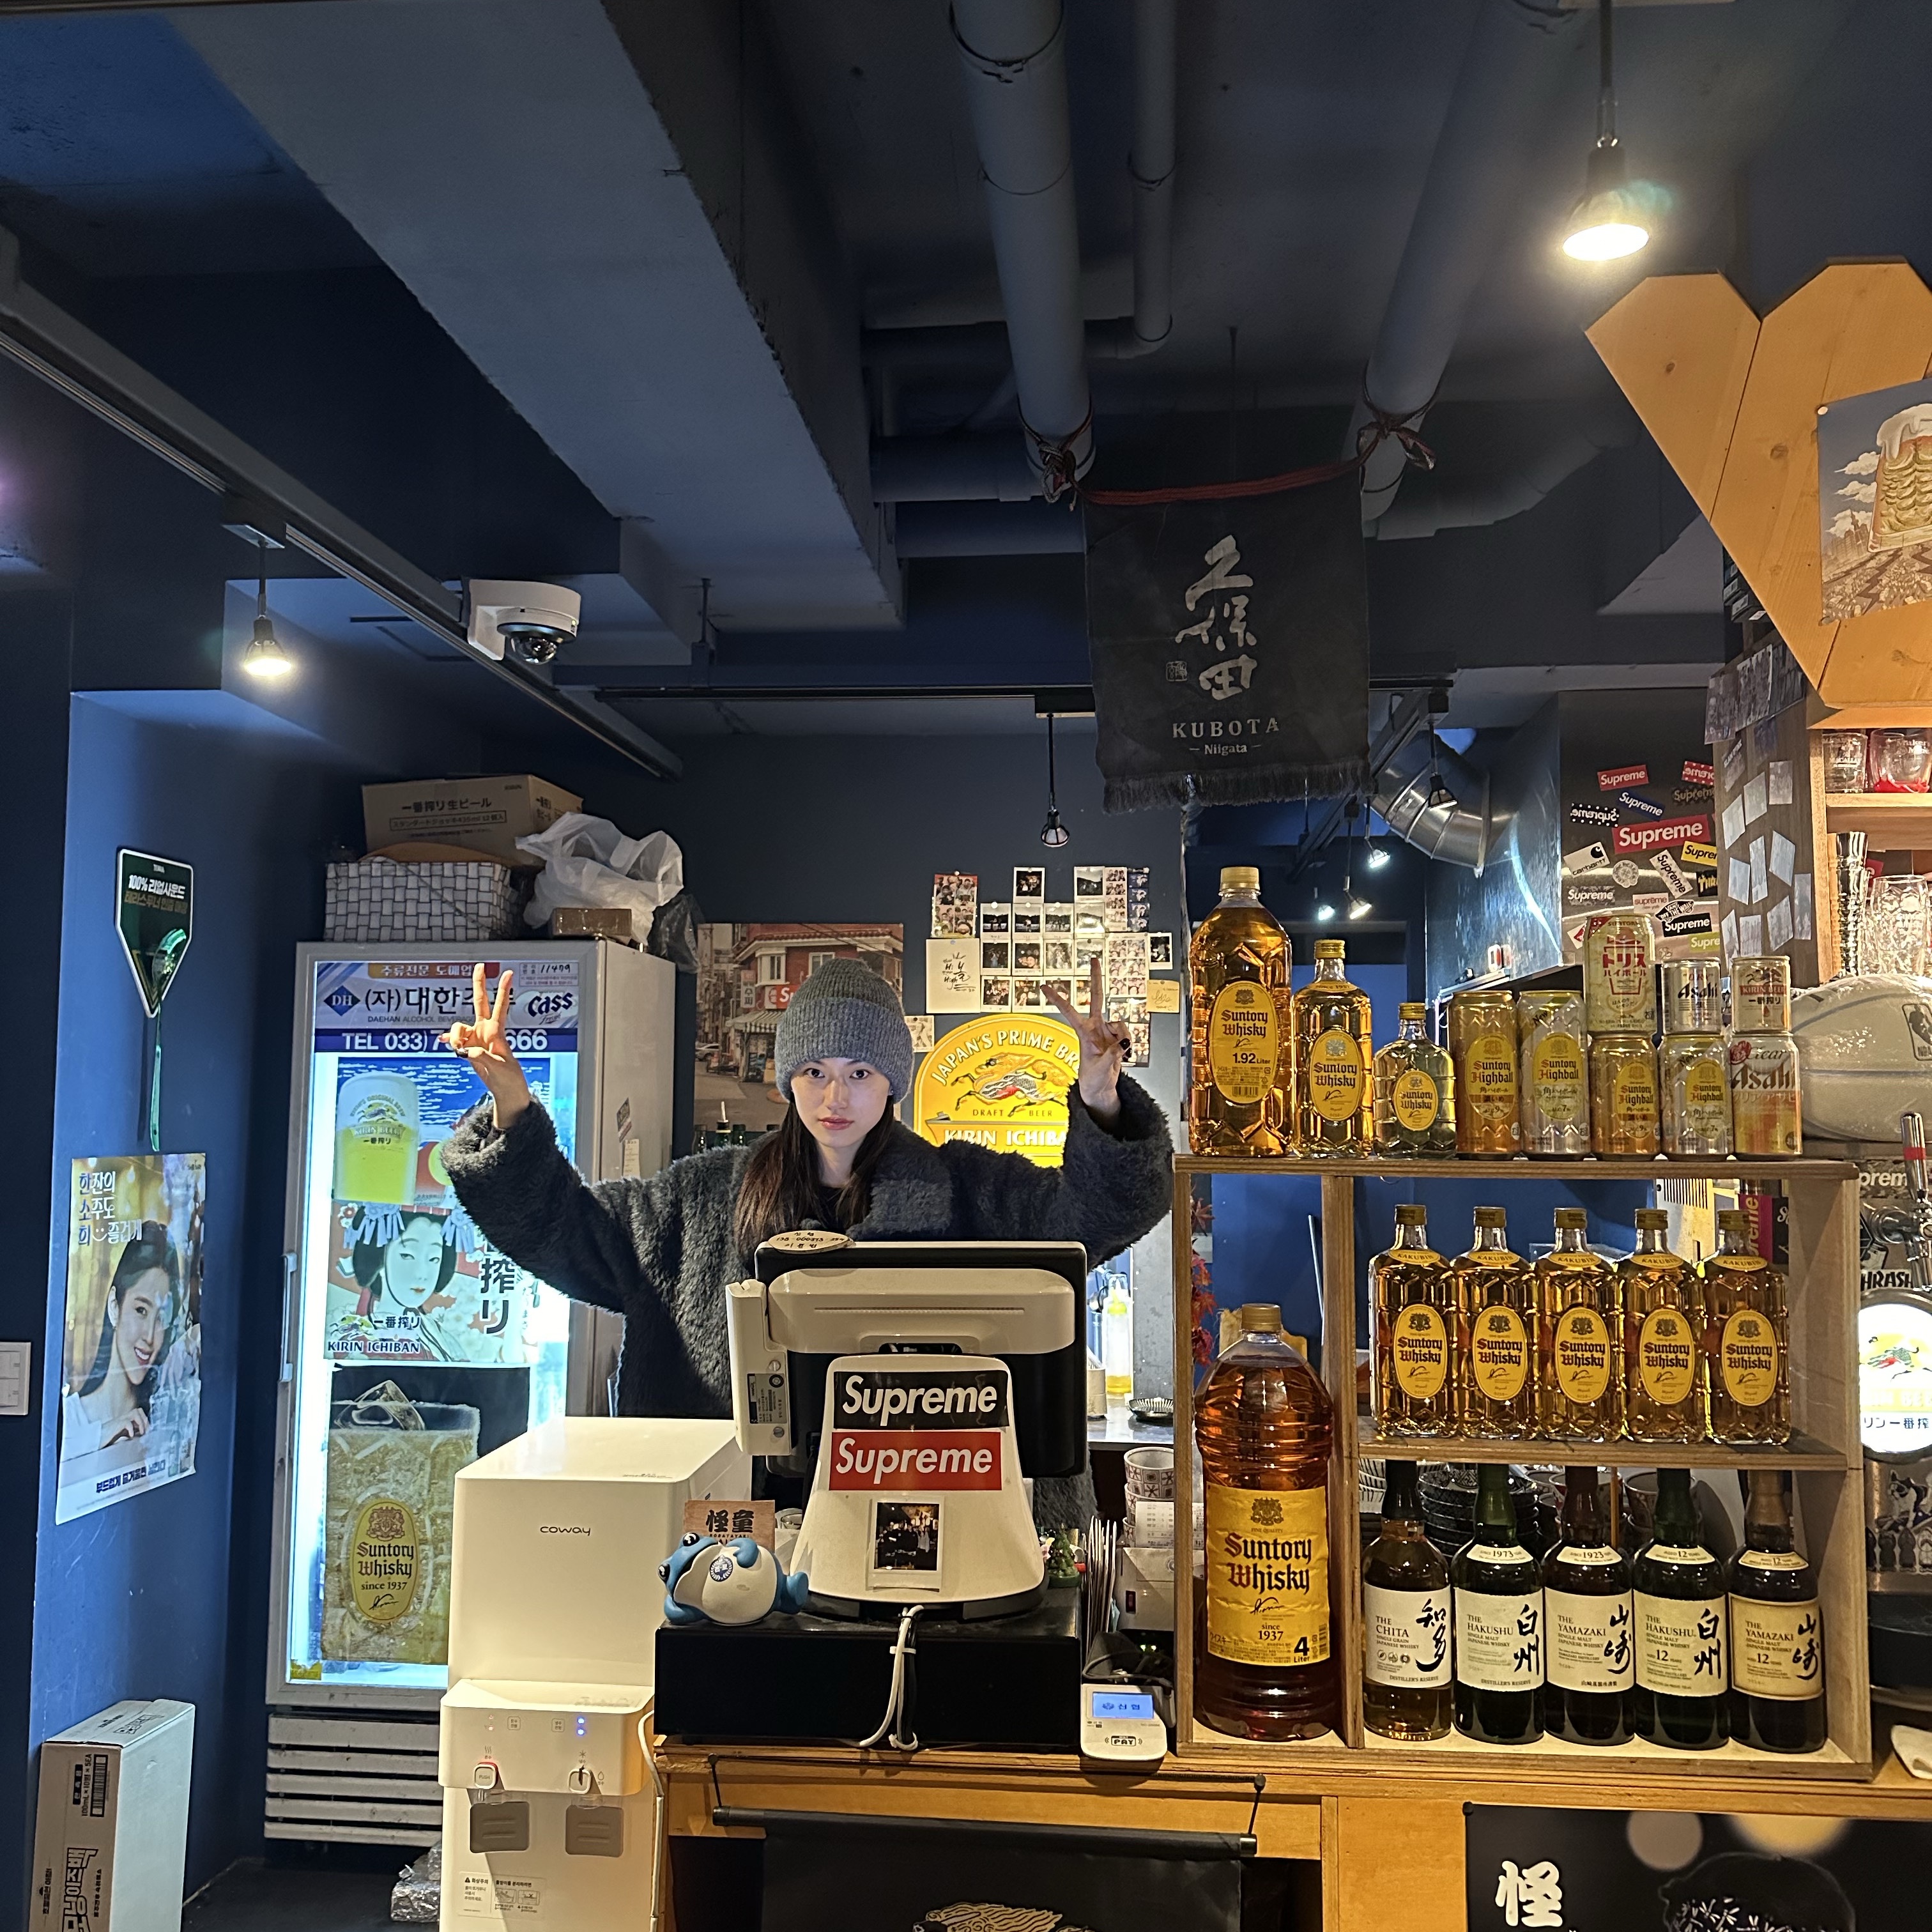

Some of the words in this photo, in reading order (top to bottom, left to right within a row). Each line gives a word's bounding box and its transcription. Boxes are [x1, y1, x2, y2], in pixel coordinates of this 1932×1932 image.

[1175, 534, 1257, 701] 久保田
[1173, 717, 1280, 739] KUBOTA
[1600, 770, 1646, 786] Supreme
[1619, 792, 1663, 816] Supreme
[1619, 822, 1703, 850] Supreme
[1572, 858, 1606, 876] carhartt
[1657, 854, 1686, 893] Supreme
[128, 875, 148, 891] 100%
[148, 878, 186, 900] 리얼사운드
[1567, 889, 1614, 903] Supreme
[1664, 918, 1710, 933] Supreme
[1690, 937, 1720, 950] Supre
[1602, 953, 1646, 969] トリス
[379, 965, 431, 977] 주류전문
[1678, 982, 1718, 999] Asahi
[330, 995, 354, 1007] DH
[528, 992, 573, 1018] Cass
[1748, 997, 1781, 1005] 一番搾り
[1220, 1009, 1268, 1025] Suntory
[1222, 1023, 1267, 1039] Whisky
[342, 1032, 379, 1050] TEL
[931, 1032, 993, 1086] JAPAN'S
[997, 1029, 1054, 1052] PRIME
[1232, 1052, 1256, 1064] 1.92
[1540, 1059, 1577, 1070] Suntory
[1313, 1062, 1358, 1076] Suntory
[1473, 1060, 1511, 1071] Suntory
[1314, 1074, 1356, 1089] Whisky
[1471, 1071, 1514, 1086] Highball
[1538, 1069, 1579, 1082] Highball
[1399, 1090, 1433, 1102] Suntory
[1620, 1085, 1652, 1094] Suntory
[1692, 1084, 1722, 1093] Suntory
[1618, 1093, 1654, 1107] Highball
[1690, 1092, 1723, 1103] Highball
[1400, 1100, 1432, 1112] Whisky
[944, 1130, 997, 1147] KIRIN
[1006, 1130, 1067, 1146] ICHIBA
[79, 1170, 116, 1195] 한잔의
[1859, 1172, 1907, 1187] prem
[79, 1196, 116, 1221] 소주도
[79, 1224, 92, 1246] 희
[107, 1218, 142, 1244] 즐겁게
[1397, 1252, 1434, 1261] KAKUBIN
[1476, 1254, 1514, 1262] KAKUBIN
[1722, 1259, 1761, 1267] KAKUBIN
[374, 1315, 422, 1330] 一番搾り
[327, 1341, 363, 1353] KIRIN
[367, 1342, 420, 1353] ICHIBAN
[1397, 1336, 1443, 1351] Suntory
[1476, 1337, 1523, 1353] Suntory
[1558, 1340, 1606, 1354] Suntory
[1643, 1341, 1690, 1357] Suntory
[1725, 1343, 1773, 1358] Suntory
[1398, 1350, 1441, 1365] Whisky
[1477, 1351, 1522, 1367] Whisky
[1560, 1353, 1604, 1368] Whisky
[1644, 1354, 1689, 1370] Whisky
[1726, 1356, 1772, 1372] Whisky
[842, 1374, 998, 1427] Supreme
[835, 1438, 993, 1485] Supreme
[705, 1509, 755, 1533] 怪童
[539, 1524, 592, 1537] coway
[356, 1542, 415, 1561] Suntory
[1223, 1531, 1312, 1565] Suntory
[1583, 1551, 1605, 1559] 1923
[358, 1559, 413, 1579] Whisky
[360, 1581, 385, 1591] since
[387, 1581, 408, 1591] 1937
[1226, 1562, 1310, 1596] Whisky
[1376, 1615, 1392, 1625] THE
[1467, 1614, 1482, 1624] THE
[1557, 1614, 1574, 1625] THE
[1645, 1614, 1661, 1625] THE
[1745, 1620, 1763, 1630] THE
[1257, 1630, 1284, 1641] 1937
[1376, 1624, 1409, 1637] CHITA
[1467, 1622, 1514, 1636] HAKUSHU
[1558, 1623, 1606, 1637] YAMAZAKI
[1745, 1629, 1794, 1642] YAMAZAKI
[1293, 1636, 1310, 1657] 4
[1376, 1640, 1399, 1648] JAPANESE
[1514, 1604, 1540, 1676] 白州
[1604, 1603, 1632, 1675] 山崎
[1694, 1607, 1721, 1680] 白州
[1792, 1613, 1820, 1681] 山崎
[1293, 1655, 1310, 1664] Liter
[1655, 1649, 1669, 1662] 12
[1756, 1653, 1770, 1665] 12
[1494, 1860, 1563, 1929] 怪
